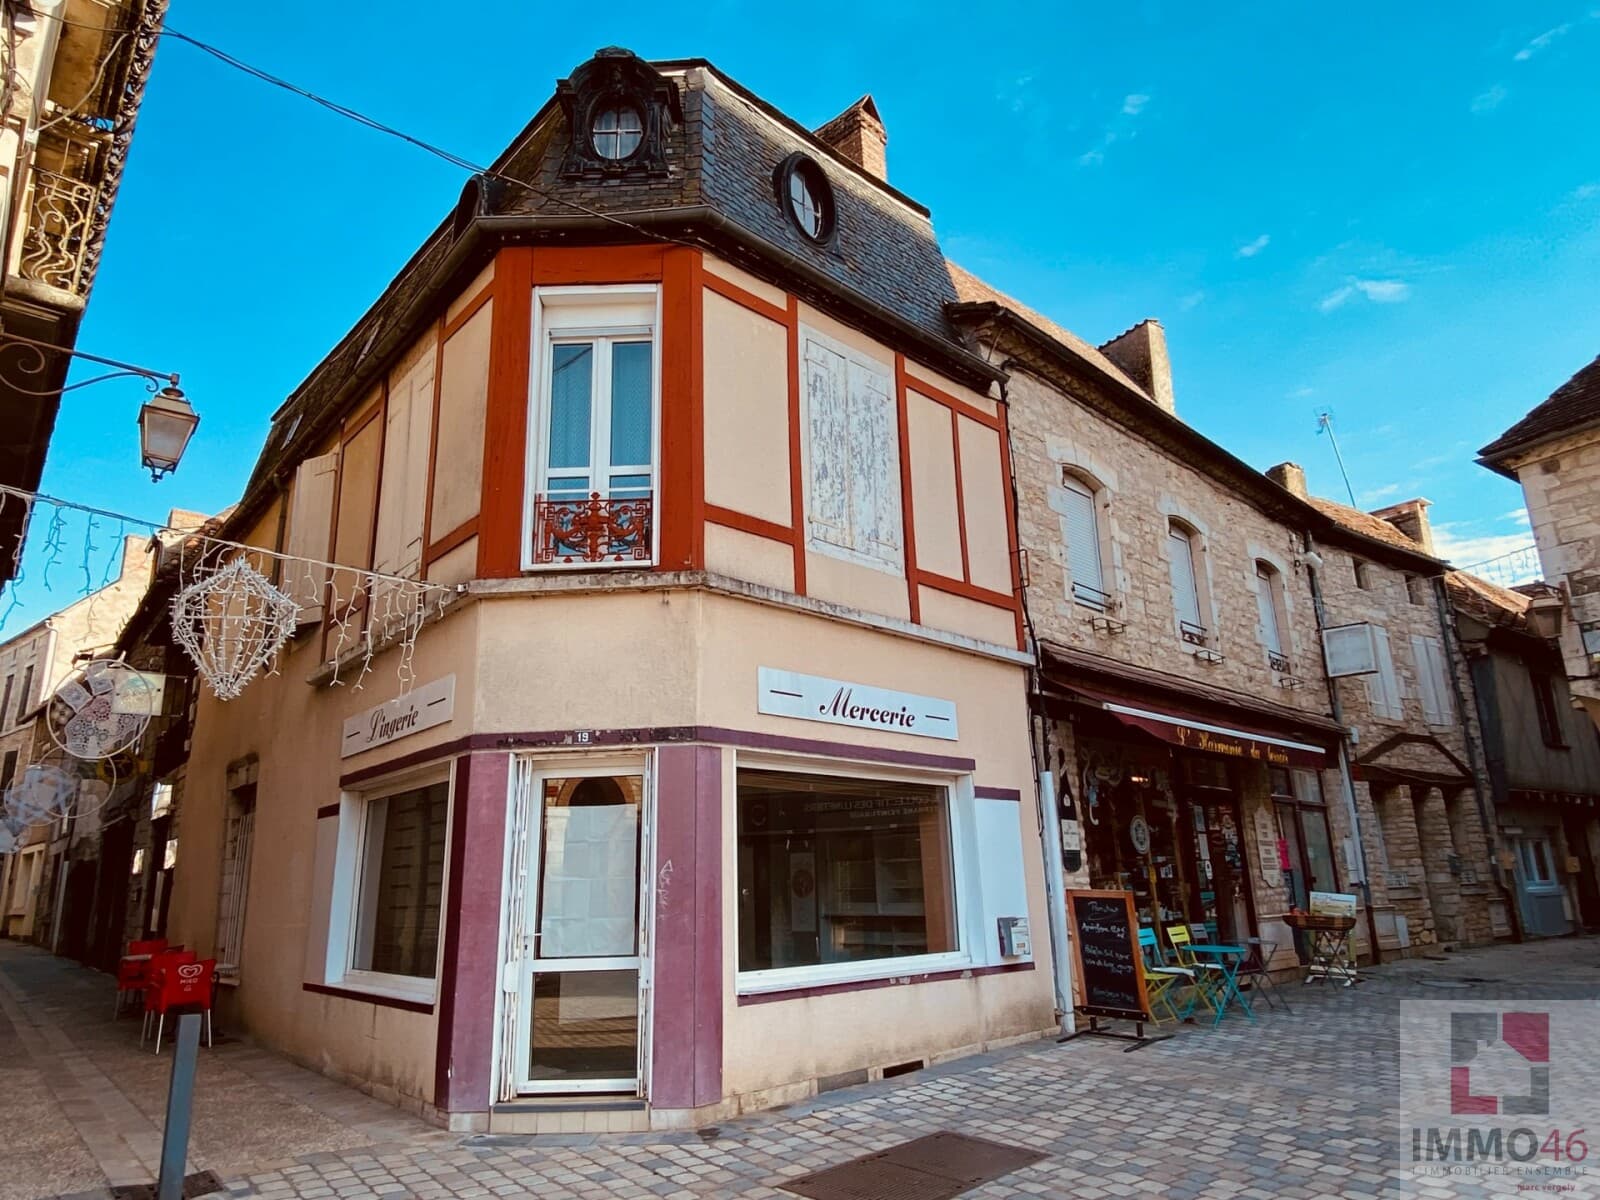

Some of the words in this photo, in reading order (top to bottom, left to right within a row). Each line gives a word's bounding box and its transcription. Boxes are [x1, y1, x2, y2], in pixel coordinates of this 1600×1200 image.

[366, 705, 419, 743] Lingerie
[819, 686, 916, 728] Mercerie
[577, 732, 589, 742] 19
